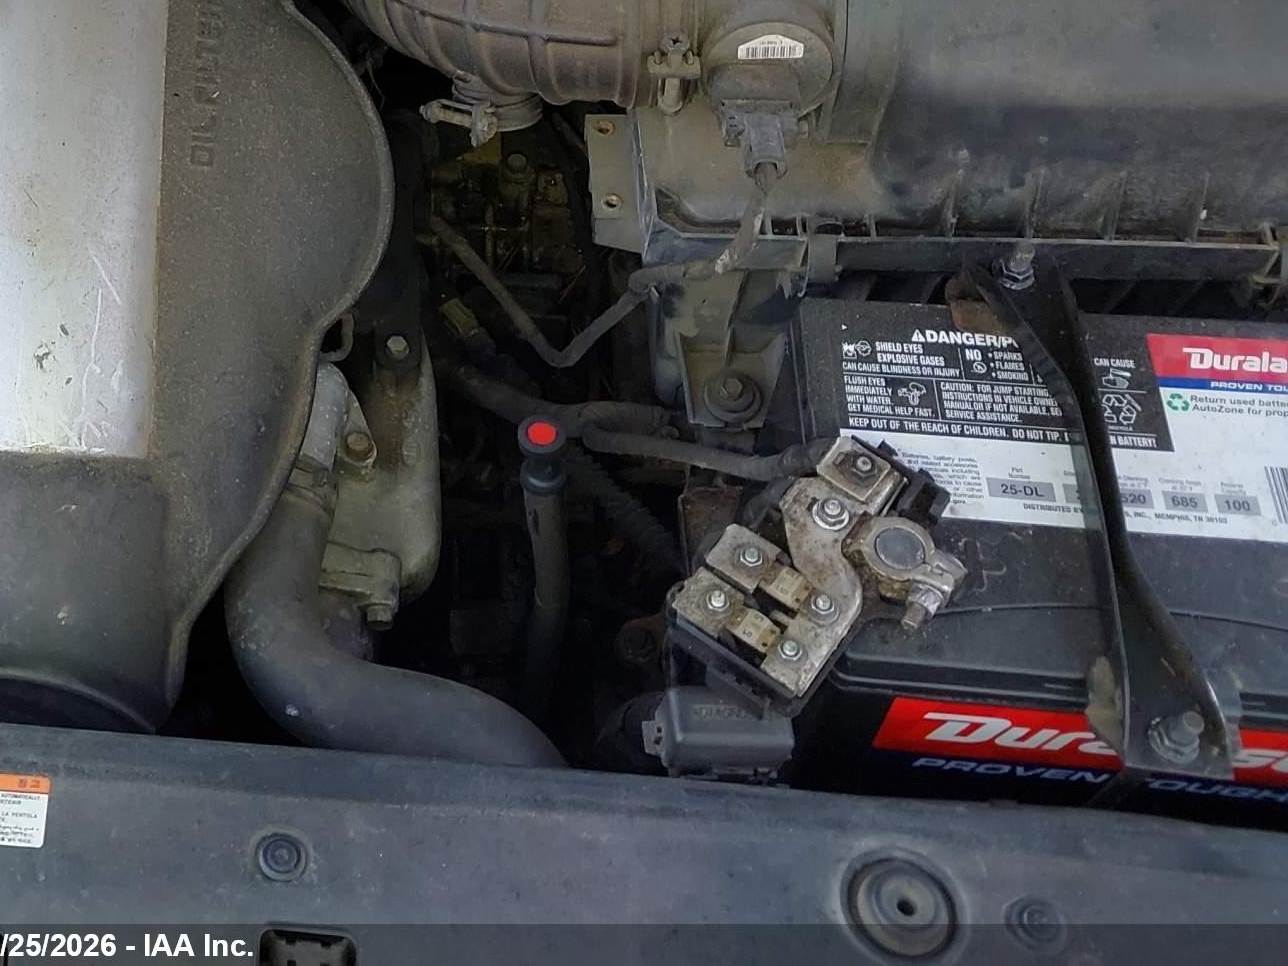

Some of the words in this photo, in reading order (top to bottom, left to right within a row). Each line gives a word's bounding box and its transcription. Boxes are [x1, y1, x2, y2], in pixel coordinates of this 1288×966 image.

[875, 341, 902, 352] SHIELD
[903, 343, 923, 354] EYES
[876, 353, 918, 365] EXPLOSIVE
[919, 356, 945, 366] GASES
[965, 348, 982, 361] NO
[993, 351, 1023, 361] SPARKS
[842, 361, 857, 371] CAN
[857, 362, 881, 372] CAUSE
[881, 364, 921, 375] BLINDNESS
[922, 366, 933, 375] OR
[934, 367, 960, 377] INJURY
[995, 361, 1025, 371] FLAMES
[1094, 357, 1110, 367] CAN
[1110, 358, 1136, 369] CAUSE
[844, 375, 867, 385] FLUSH
[868, 377, 886, 386] EYES
[996, 371, 1029, 381] SMOKING
[845, 385, 892, 397] IMMEDIATELY
[940, 381, 974, 392] CAUTION:
[977, 383, 992, 393] FOR
[993, 384, 1013, 395] JUMP
[1210, 381, 1263, 390] PROVEN
[846, 394, 864, 404] WITH
[942, 391, 993, 403] INSTRUCTIONS
[994, 394, 1003, 403] IN
[1003, 395, 1032, 405] VEHICLE
[1190, 394, 1227, 404] Return
[1230, 397, 1256, 407] used
[847, 403, 861, 412] GET
[862, 404, 894, 415] MEDICAL
[895, 406, 914, 416] HELP
[945, 409, 974, 420] SERVICE
[993, 404, 1008, 413] NOT
[1192, 404, 1245, 415] AutoZone
[1248, 407, 1263, 415] for
[849, 417, 869, 427] KEEP
[871, 418, 887, 428] OUT
[889, 419, 901, 430] OF
[903, 420, 920, 431] THE
[921, 422, 949, 433] REACH
[951, 424, 962, 434] OF
[963, 424, 1010, 437] CHILDREN.
[1012, 428, 1025, 438] DO
[1026, 429, 1044, 440] NOT
[1117, 435, 1157, 448] BATTERY!
[1000, 483, 1045, 497] 25-DL
[1023, 503, 1071, 513] DISTRIBUTED
[1172, 495, 1198, 508] 685
[1225, 500, 1251, 511] 100
[912, 757, 1112, 784] PROVEN
[1145, 777, 1288, 802] OUGH
